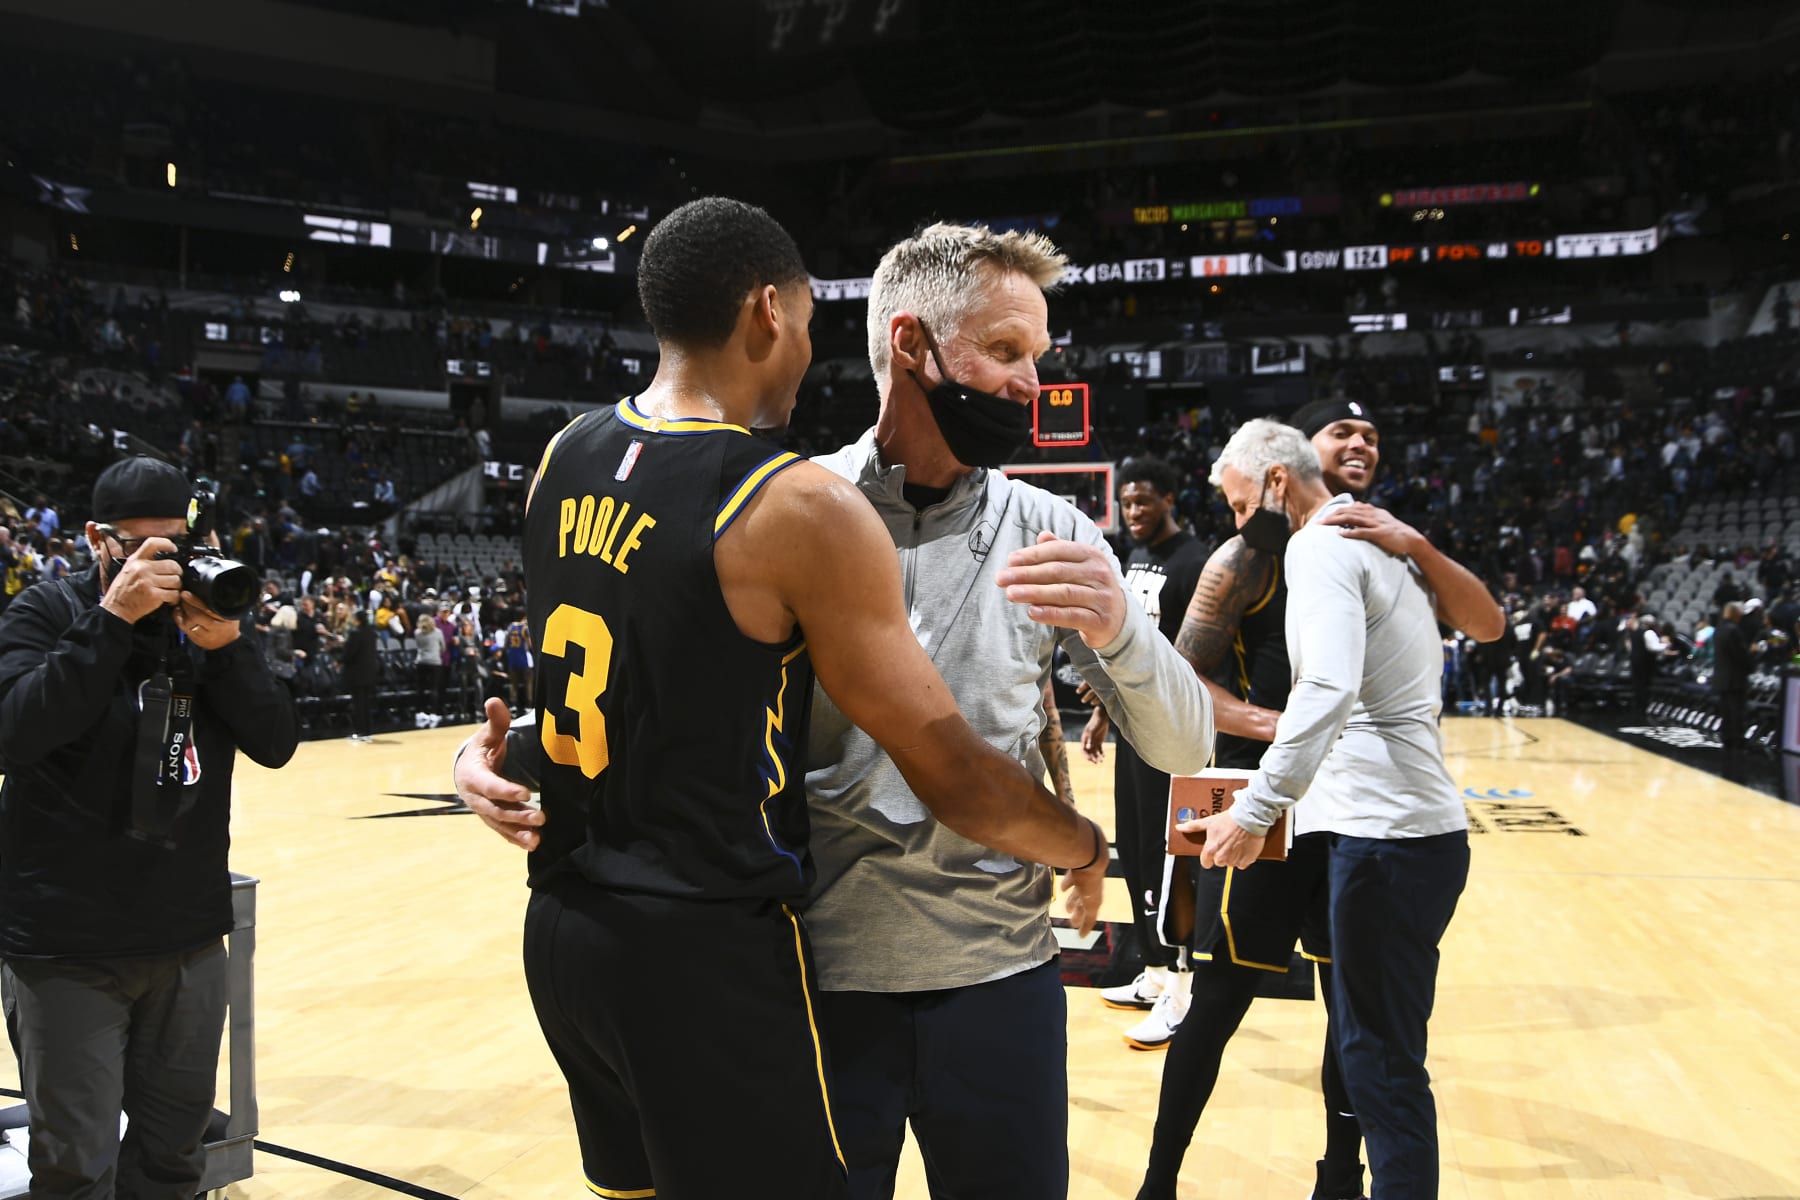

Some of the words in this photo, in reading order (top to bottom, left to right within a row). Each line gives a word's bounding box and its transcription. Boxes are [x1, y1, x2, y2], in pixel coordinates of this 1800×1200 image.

[1132, 206, 1169, 224] TACOS
[1389, 247, 1415, 262] PF
[1514, 240, 1542, 256] TO
[1353, 250, 1380, 266] 124
[1097, 264, 1122, 281] SA
[1049, 389, 1073, 406] 0.0
[559, 495, 657, 574] POOLE
[541, 603, 614, 780] 3
[178, 699, 188, 717] PRO
[168, 732, 184, 781] SONY
